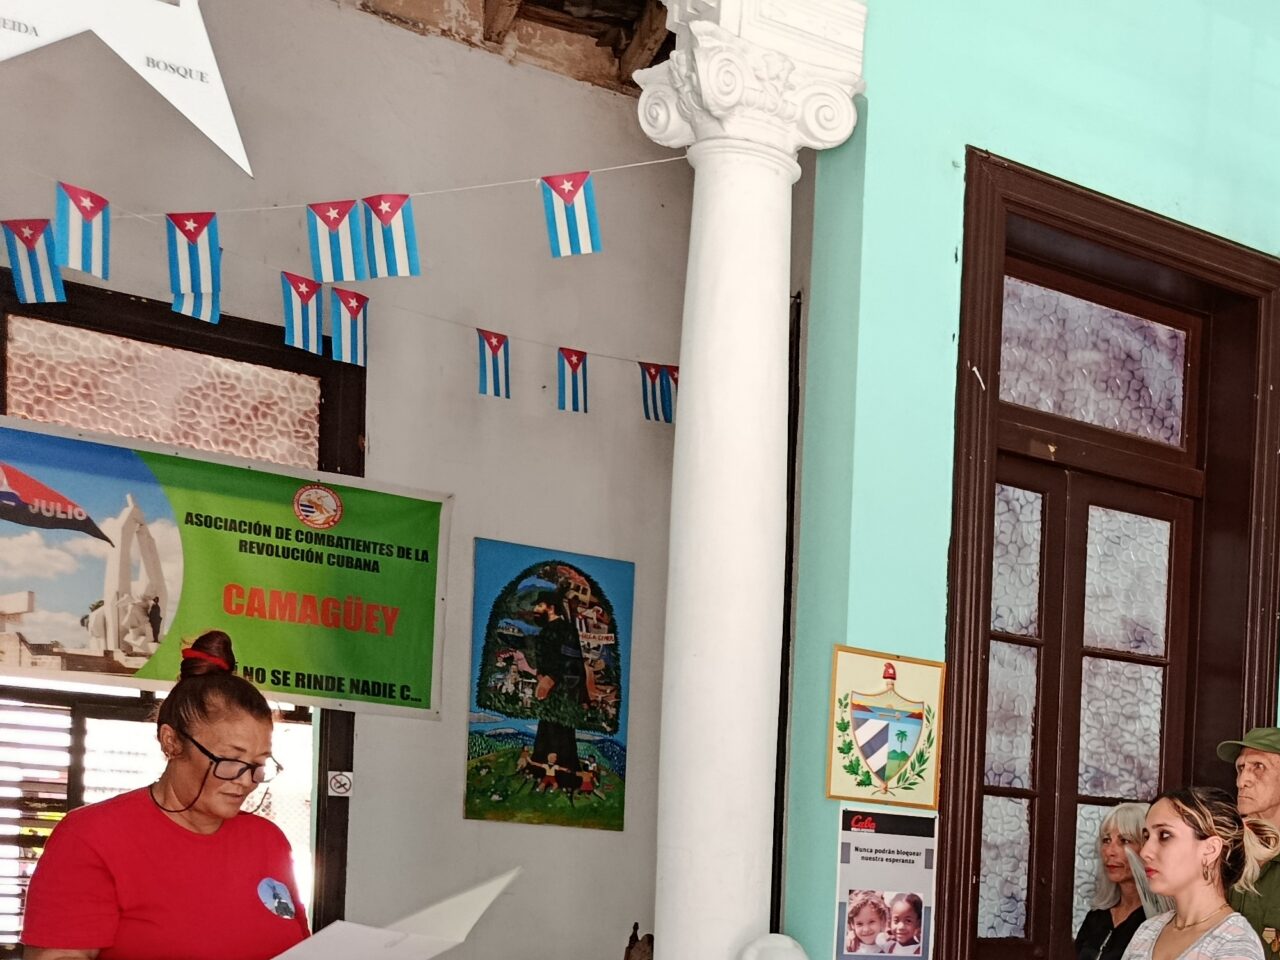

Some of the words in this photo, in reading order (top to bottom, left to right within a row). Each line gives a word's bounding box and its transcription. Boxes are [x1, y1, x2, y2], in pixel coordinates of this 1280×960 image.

[0, 16, 39, 37] EIDA
[146, 56, 209, 84] BOSQUE
[28, 498, 87, 520] JULIO
[184, 512, 272, 538] ASOCIACIÓN
[275, 528, 292, 541] DE
[295, 529, 394, 557] COMBATIENTES
[397, 545, 412, 560] DE
[414, 548, 429, 563] LA
[239, 539, 324, 565] REVOLUCIÓN
[327, 552, 380, 573] CUBANA
[223, 583, 400, 637] CAMAGÜEY
[243, 665, 266, 684] NO
[271, 669, 291, 687] SE
[295, 672, 345, 693] RINDE
[350, 678, 396, 699] NADIE
[851, 815, 876, 829] Cuba
